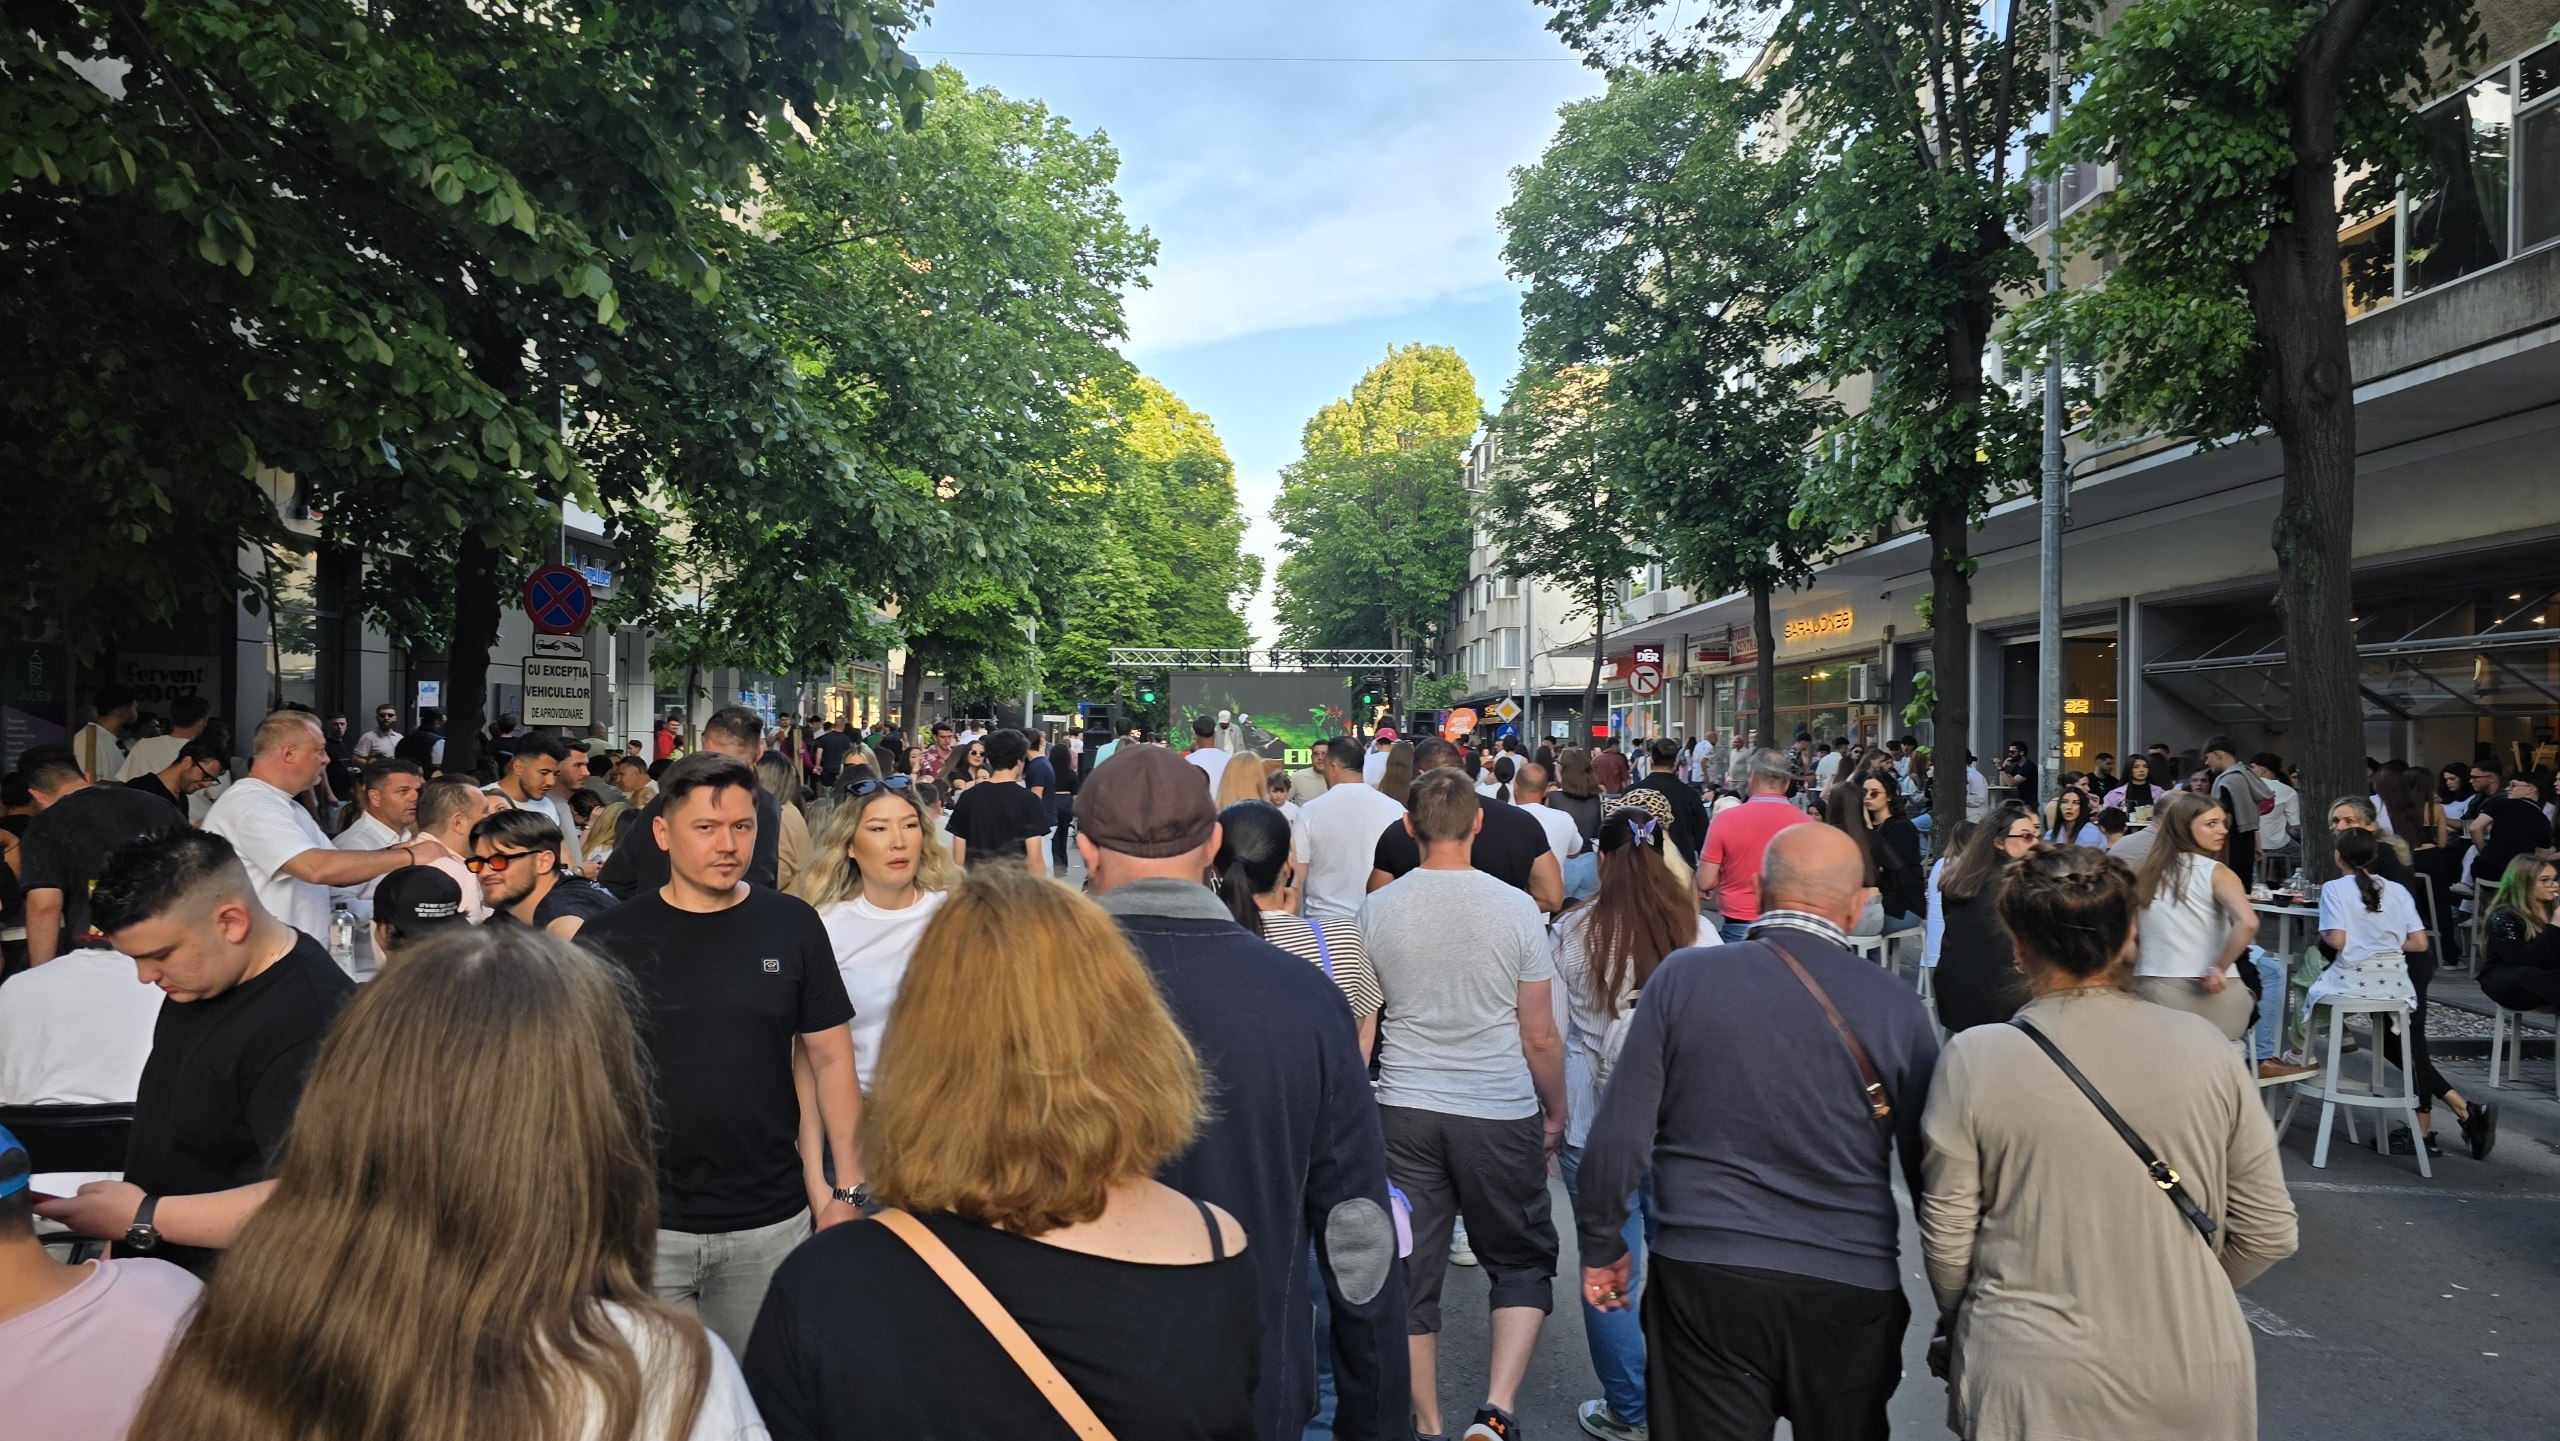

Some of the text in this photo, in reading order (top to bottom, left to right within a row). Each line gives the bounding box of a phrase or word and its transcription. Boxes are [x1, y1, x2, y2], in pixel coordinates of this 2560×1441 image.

[1737, 639, 1758, 654] CENTRA
[528, 664, 540, 676] CU
[526, 686, 590, 699] VEHICULELOR
[532, 707, 583, 719] DE APROVIZIONARE
[2064, 742, 2083, 757] RT
